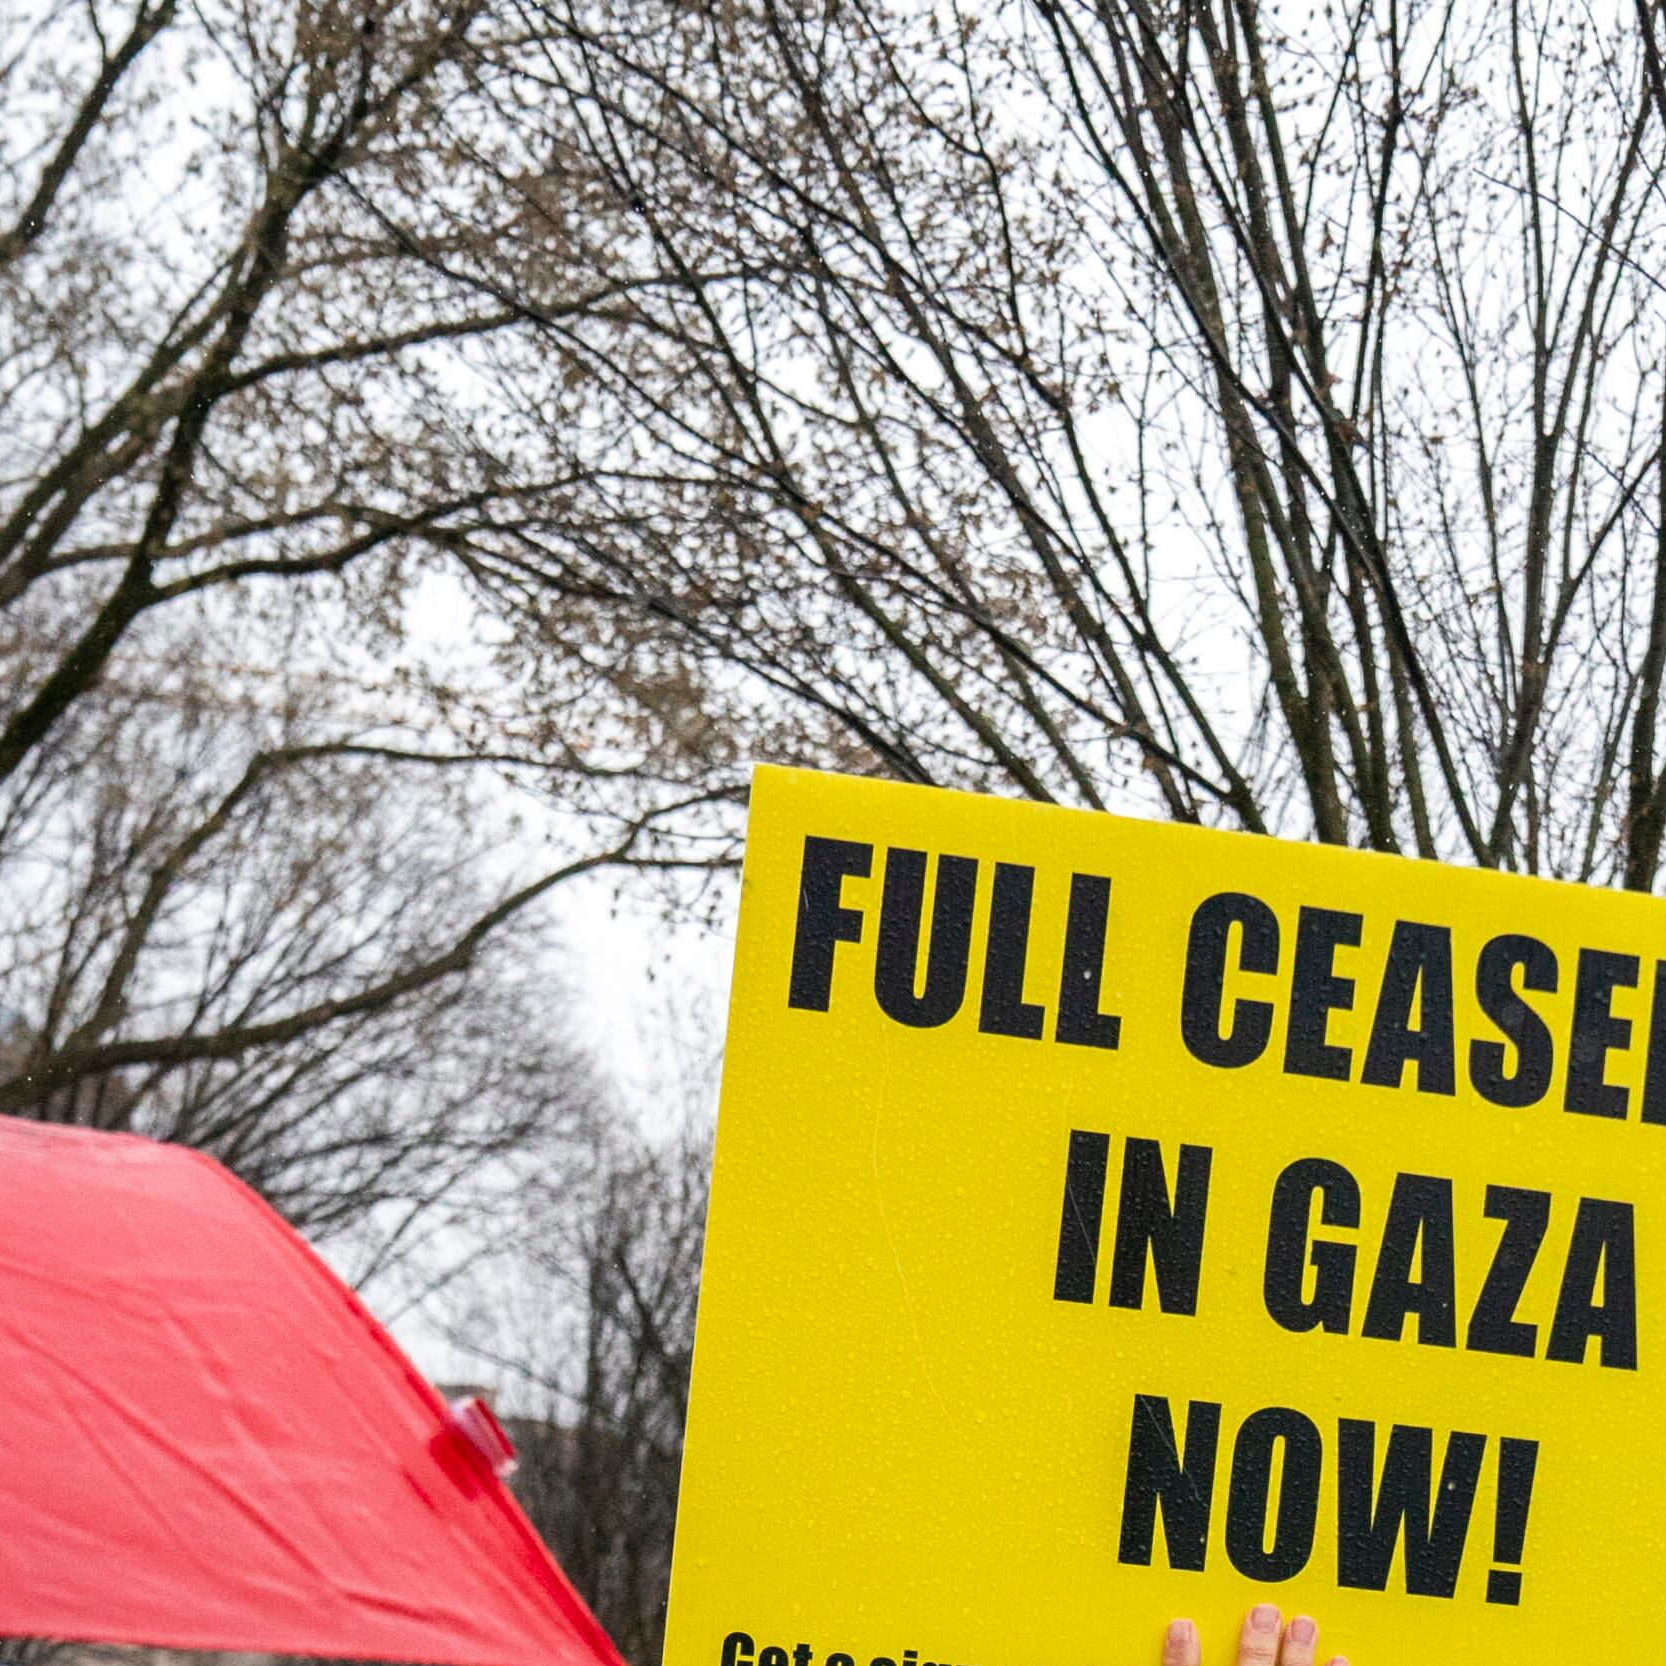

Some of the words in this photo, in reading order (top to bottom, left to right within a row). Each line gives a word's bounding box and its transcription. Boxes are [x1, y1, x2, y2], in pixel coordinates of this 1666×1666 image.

[788, 835, 1122, 1050] FULL
[1053, 1129, 1213, 1317] IN
[1263, 1157, 1638, 1371] GAZA
[1118, 1393, 1540, 1606] NOW!
